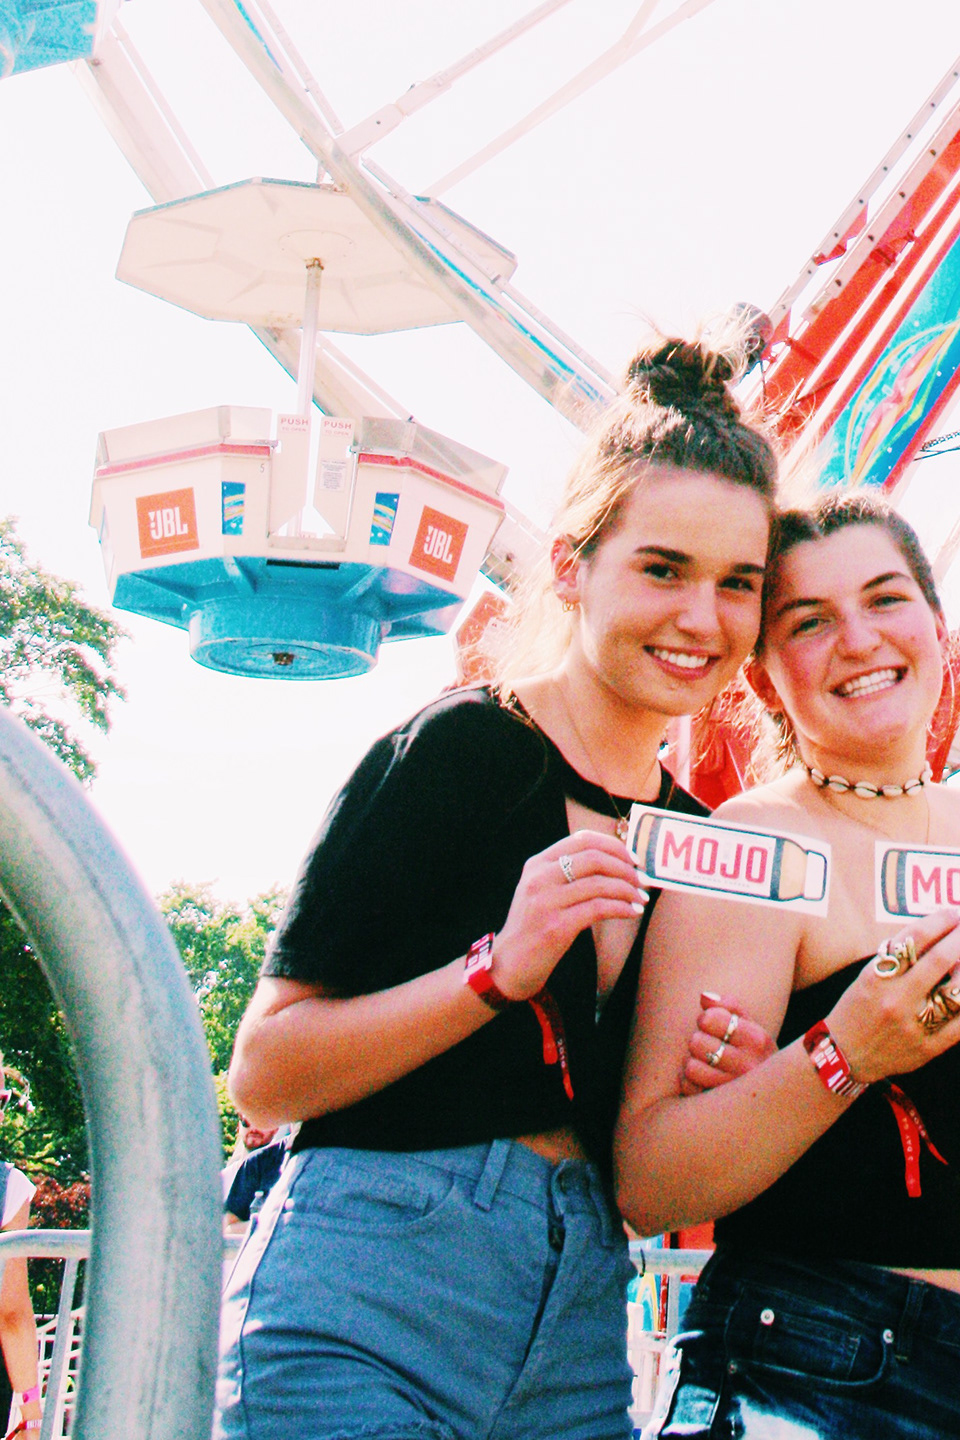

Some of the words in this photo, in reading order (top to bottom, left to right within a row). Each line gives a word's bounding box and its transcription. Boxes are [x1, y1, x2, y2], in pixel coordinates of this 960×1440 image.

[280, 417, 309, 426] PUSH
[323, 420, 352, 430] PUSH
[148, 506, 188, 540] JBL
[423, 525, 453, 564] JBL
[661, 830, 768, 884] MOJO
